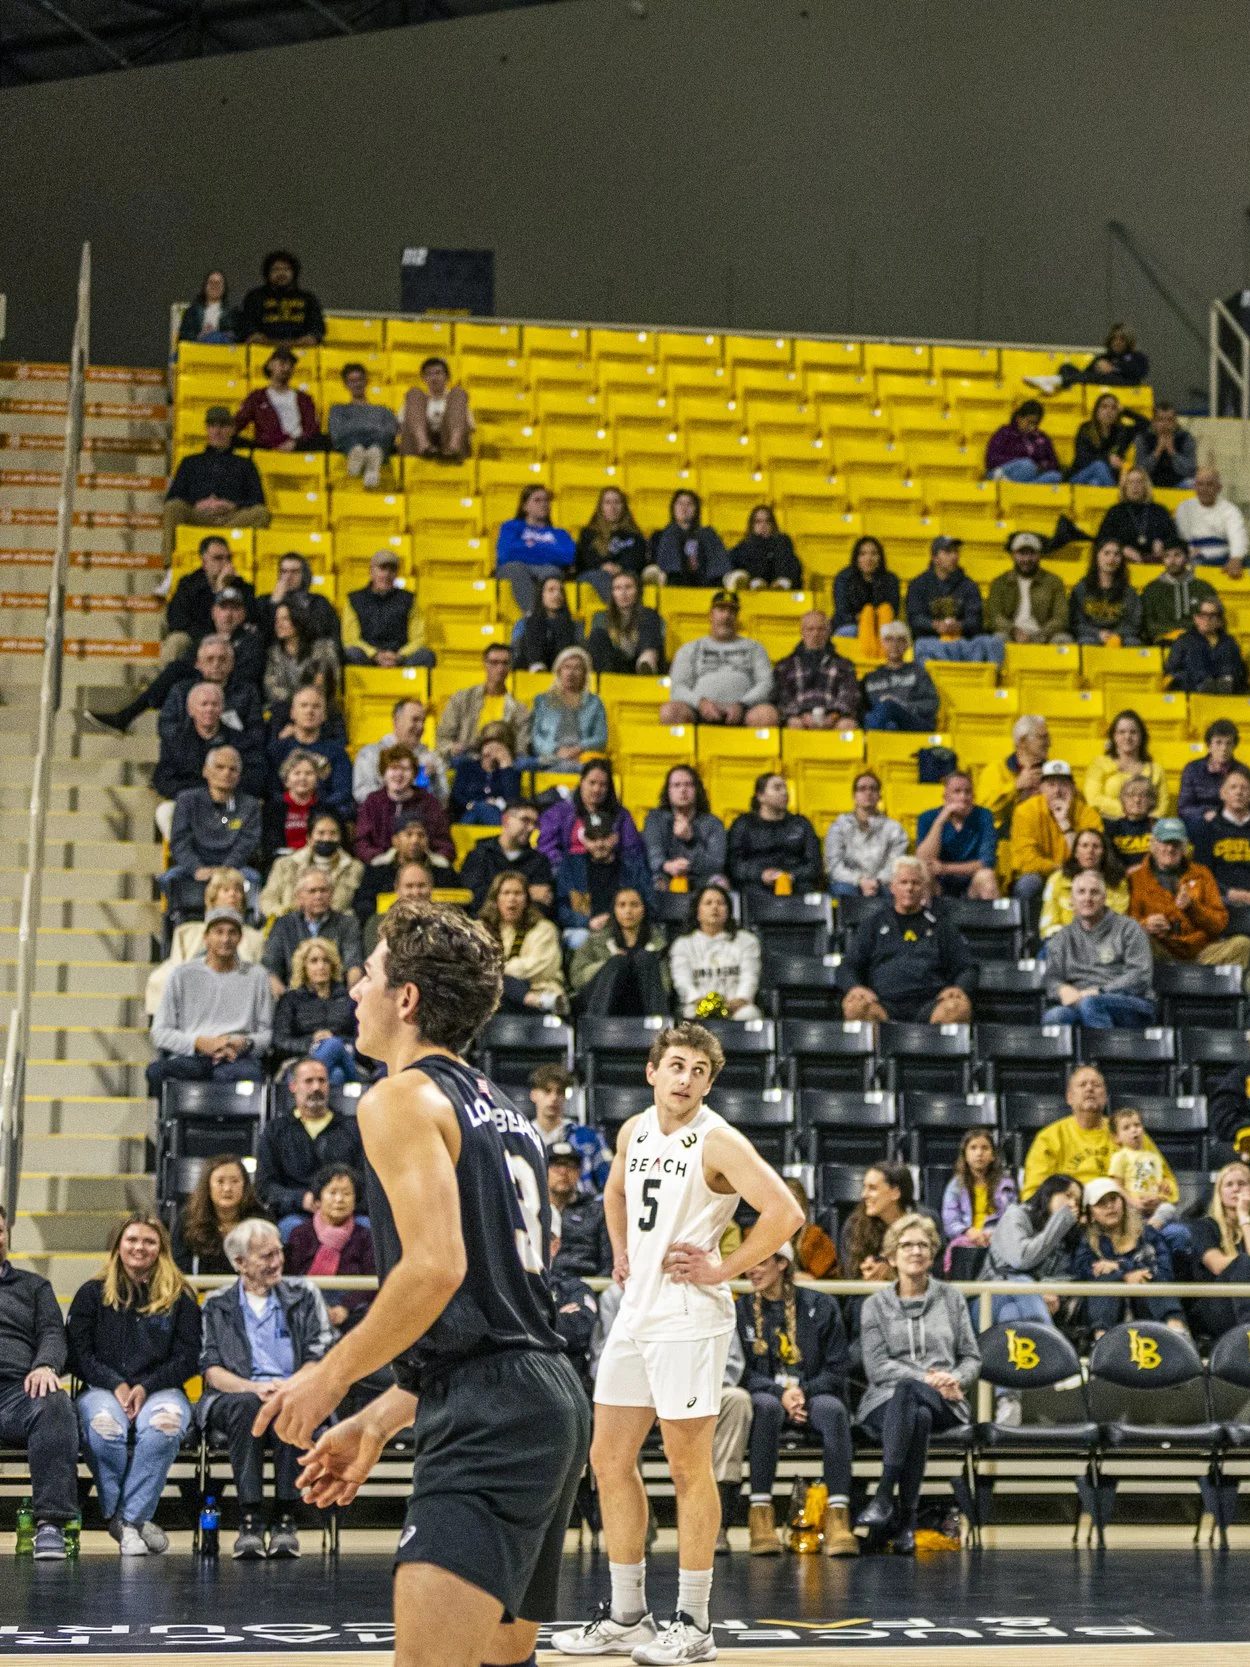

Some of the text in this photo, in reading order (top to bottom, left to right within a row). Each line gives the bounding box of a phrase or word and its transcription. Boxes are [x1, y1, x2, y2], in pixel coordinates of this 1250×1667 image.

[629, 1157, 687, 1178] BEACH
[638, 1179, 662, 1232] 5
[728, 1626, 1158, 1640] BRUCE
